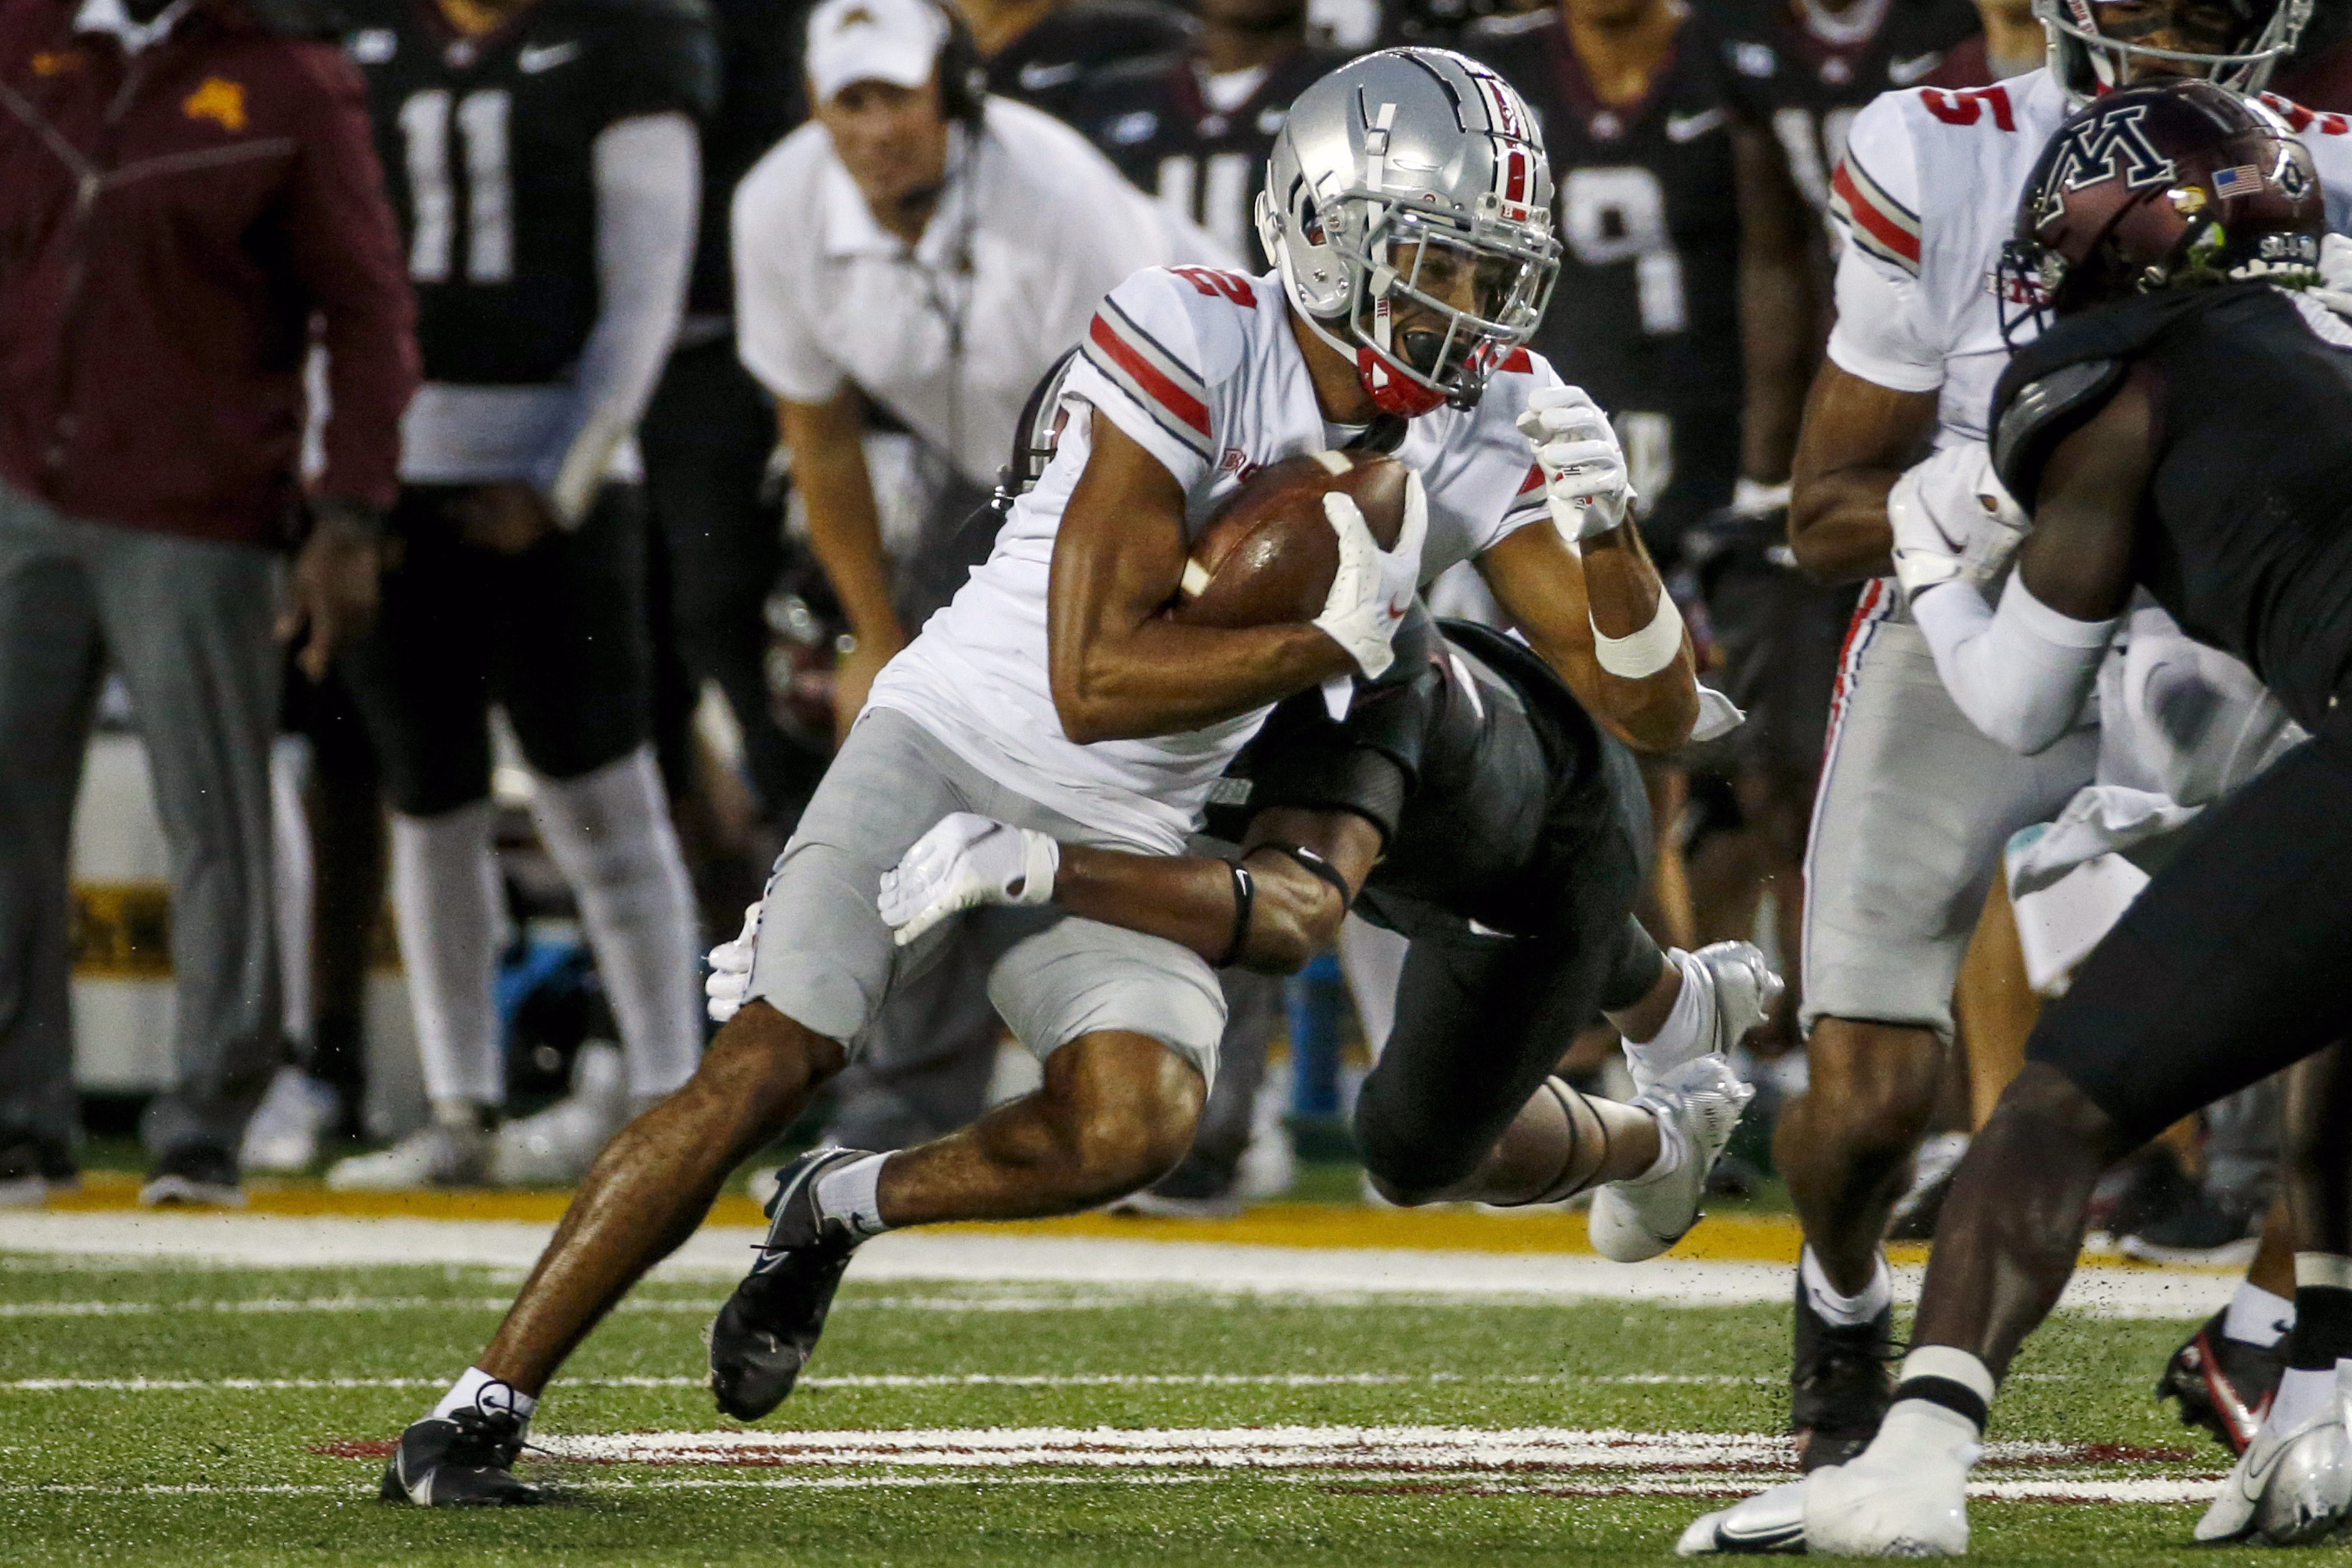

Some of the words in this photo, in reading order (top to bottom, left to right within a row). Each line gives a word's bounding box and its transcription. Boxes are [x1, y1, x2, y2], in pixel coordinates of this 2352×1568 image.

[1919, 86, 2017, 132] 5
[2035, 104, 2177, 231] M
[397, 89, 513, 282] 11
[1162, 266, 1258, 309] 2
[1561, 165, 1684, 334] 9
